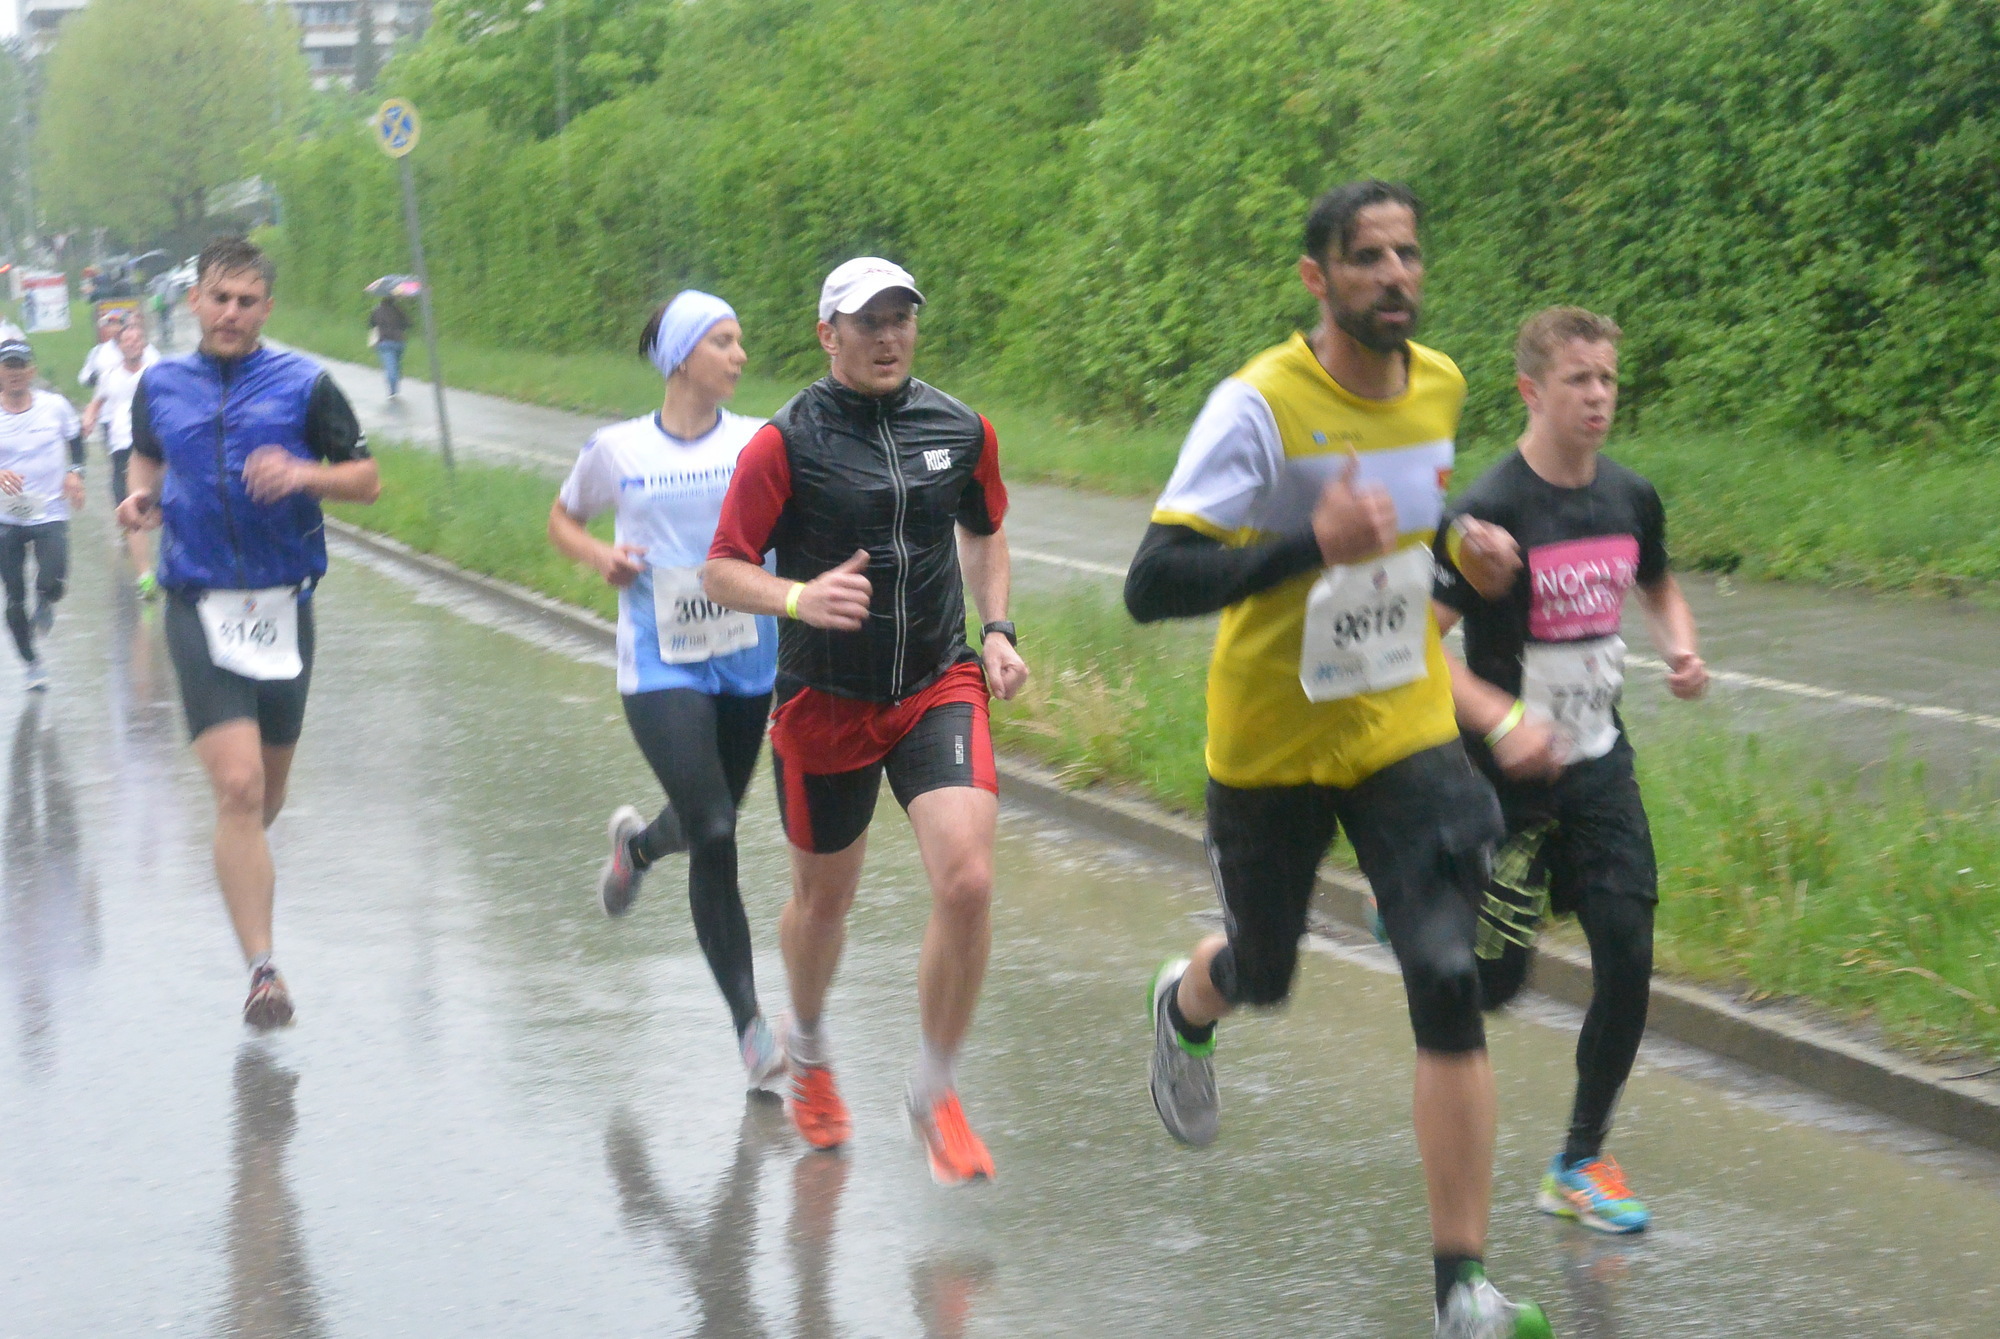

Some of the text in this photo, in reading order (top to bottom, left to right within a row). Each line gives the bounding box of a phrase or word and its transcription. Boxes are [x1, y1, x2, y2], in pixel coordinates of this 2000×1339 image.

[1536, 559, 1611, 597] NOCH
[674, 596, 735, 624] 300
[1332, 595, 1408, 648] 9616
